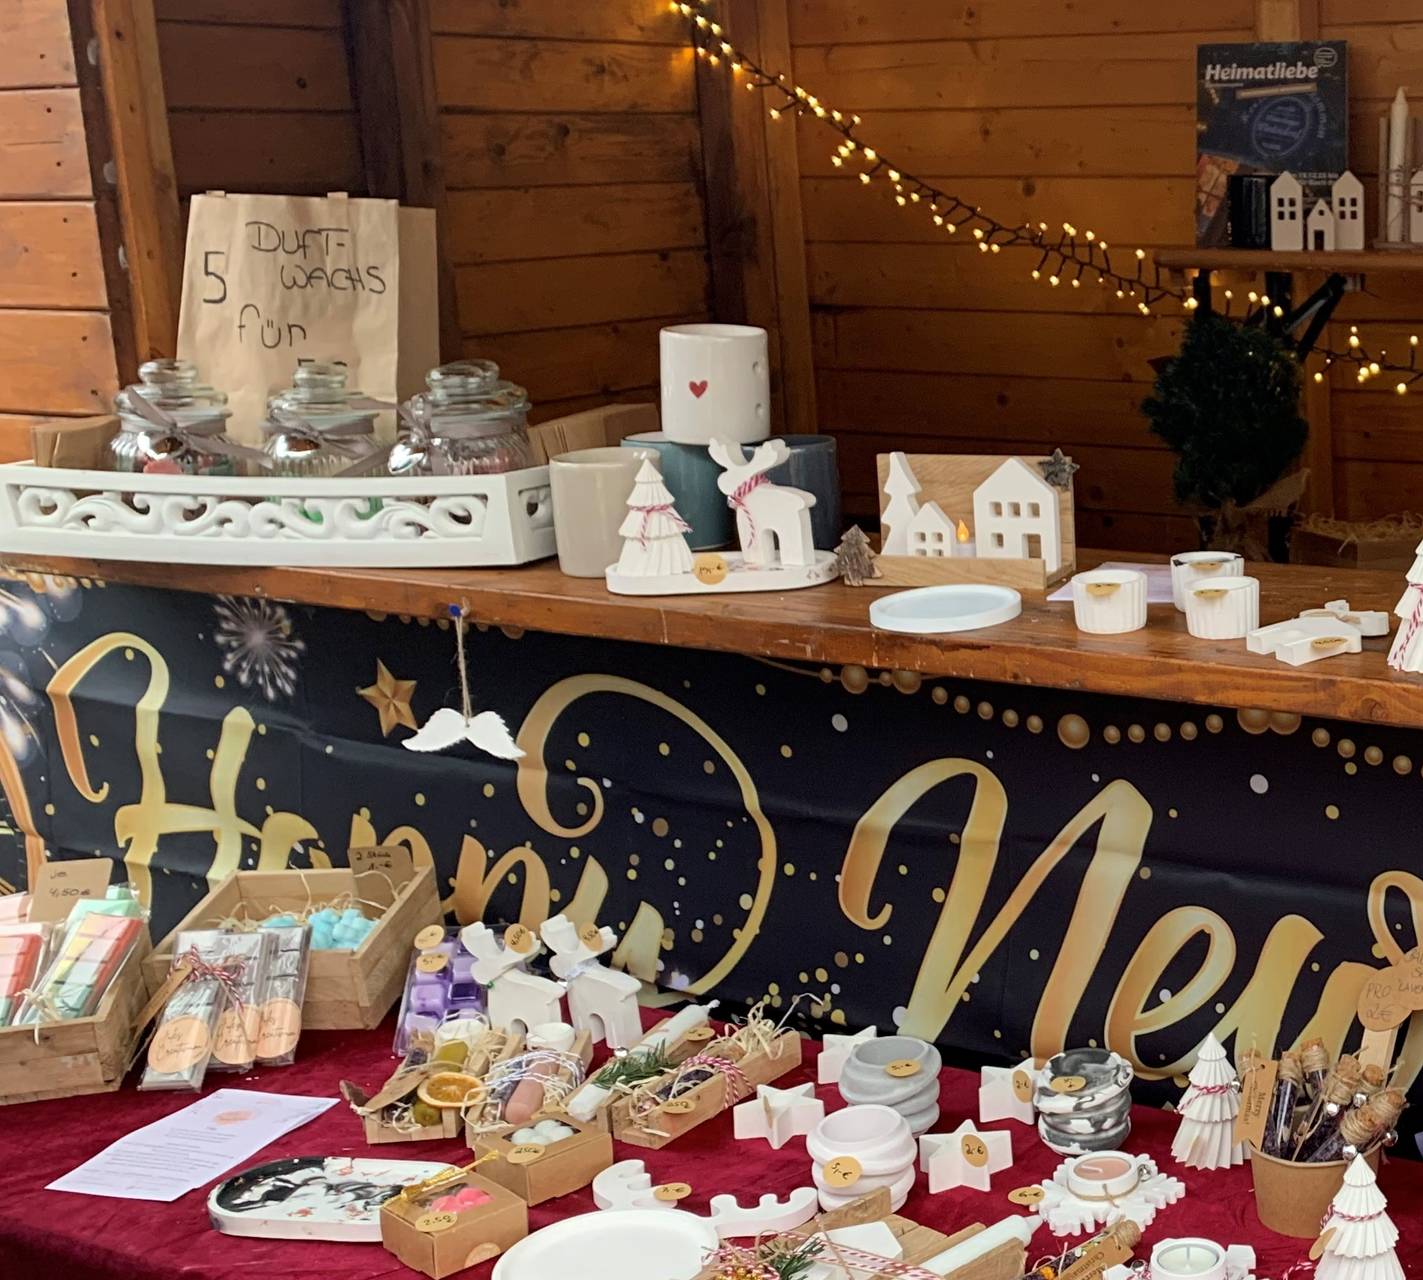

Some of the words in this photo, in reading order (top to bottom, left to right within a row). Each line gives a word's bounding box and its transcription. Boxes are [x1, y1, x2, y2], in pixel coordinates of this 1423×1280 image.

[1205, 62, 1319, 81] Heimatliebe
[202, 251, 228, 304] 5
[280, 265, 387, 294] WACHS
[238, 304, 307, 349] für
